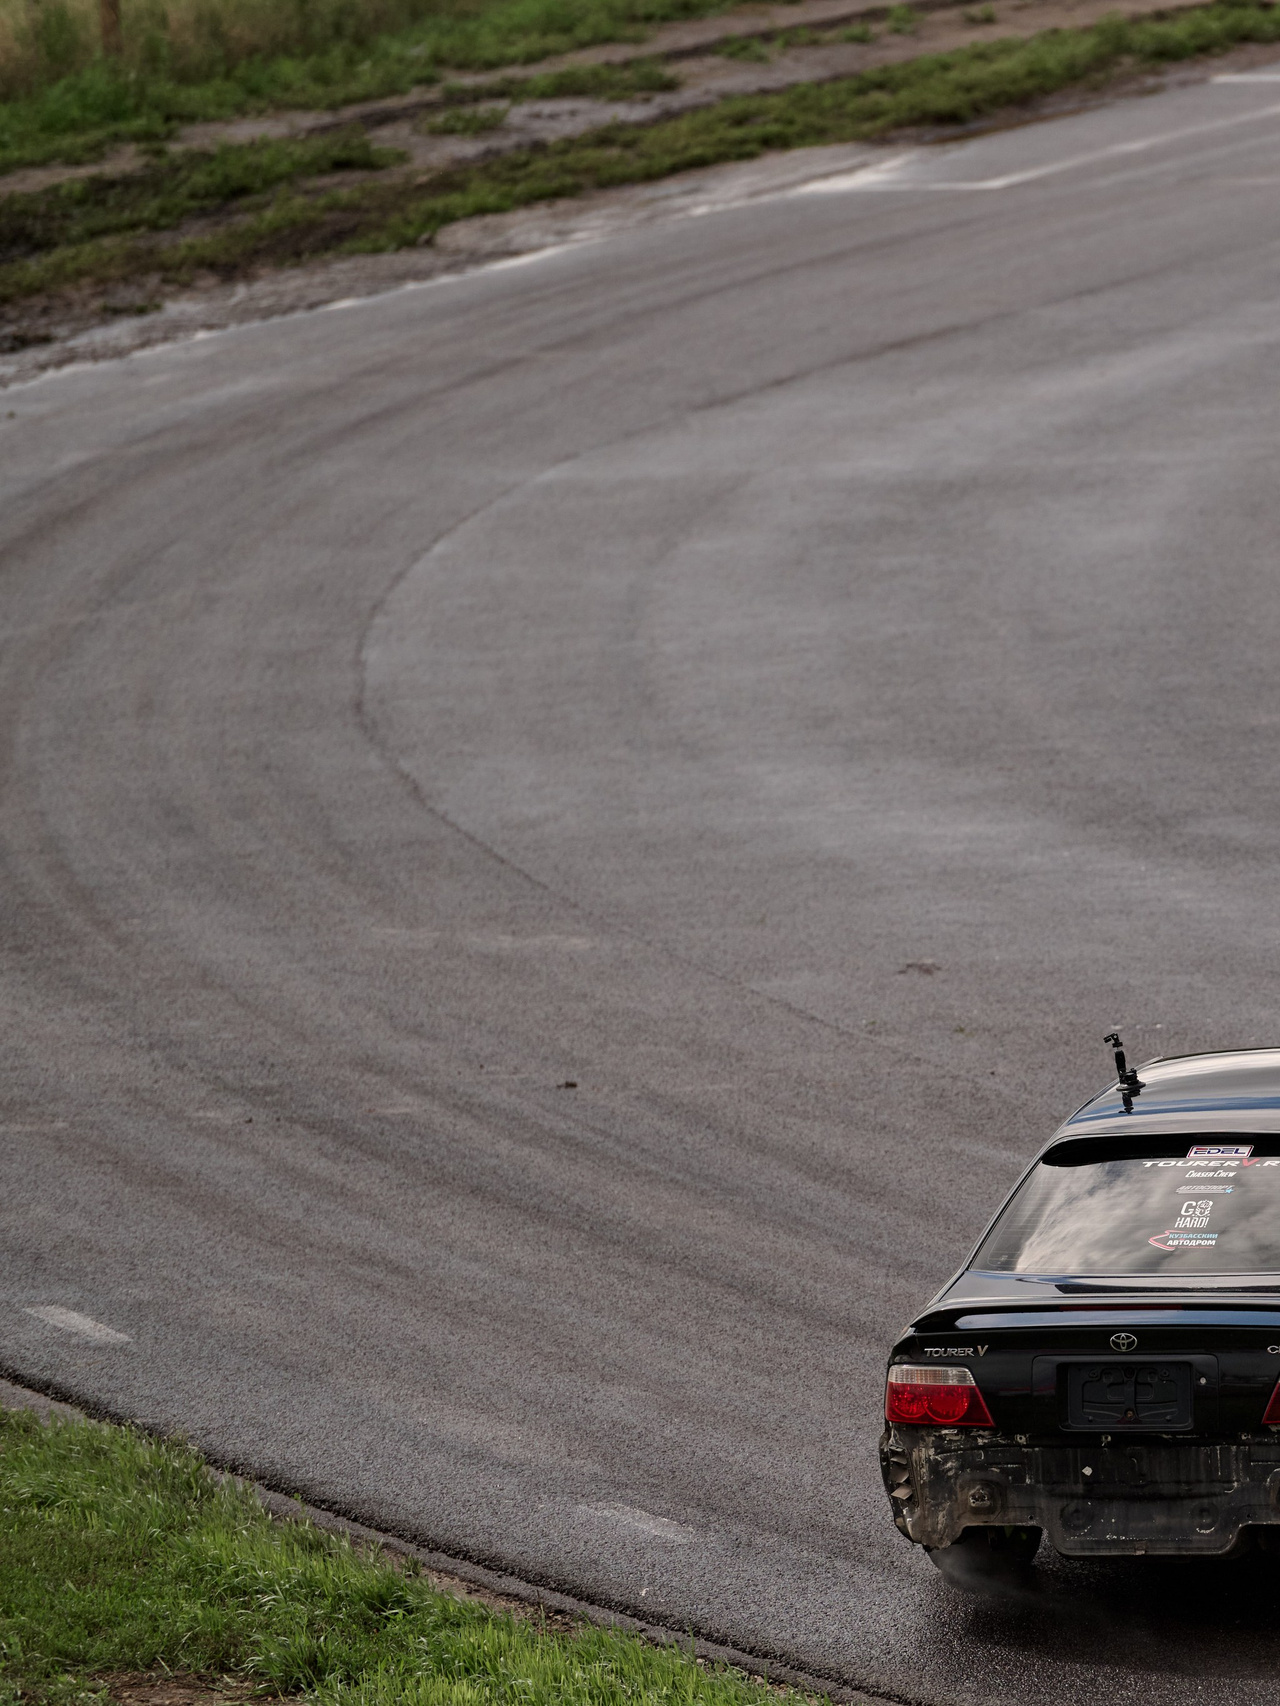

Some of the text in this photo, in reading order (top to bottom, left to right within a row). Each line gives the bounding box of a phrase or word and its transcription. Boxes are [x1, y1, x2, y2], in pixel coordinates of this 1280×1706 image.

[1192, 1147, 1247, 1155] EDEL
[1185, 1170, 1237, 1178] CHASER CREW
[1174, 1217, 1210, 1228] HARD!
[924, 1345, 989, 1357] TOURER V
